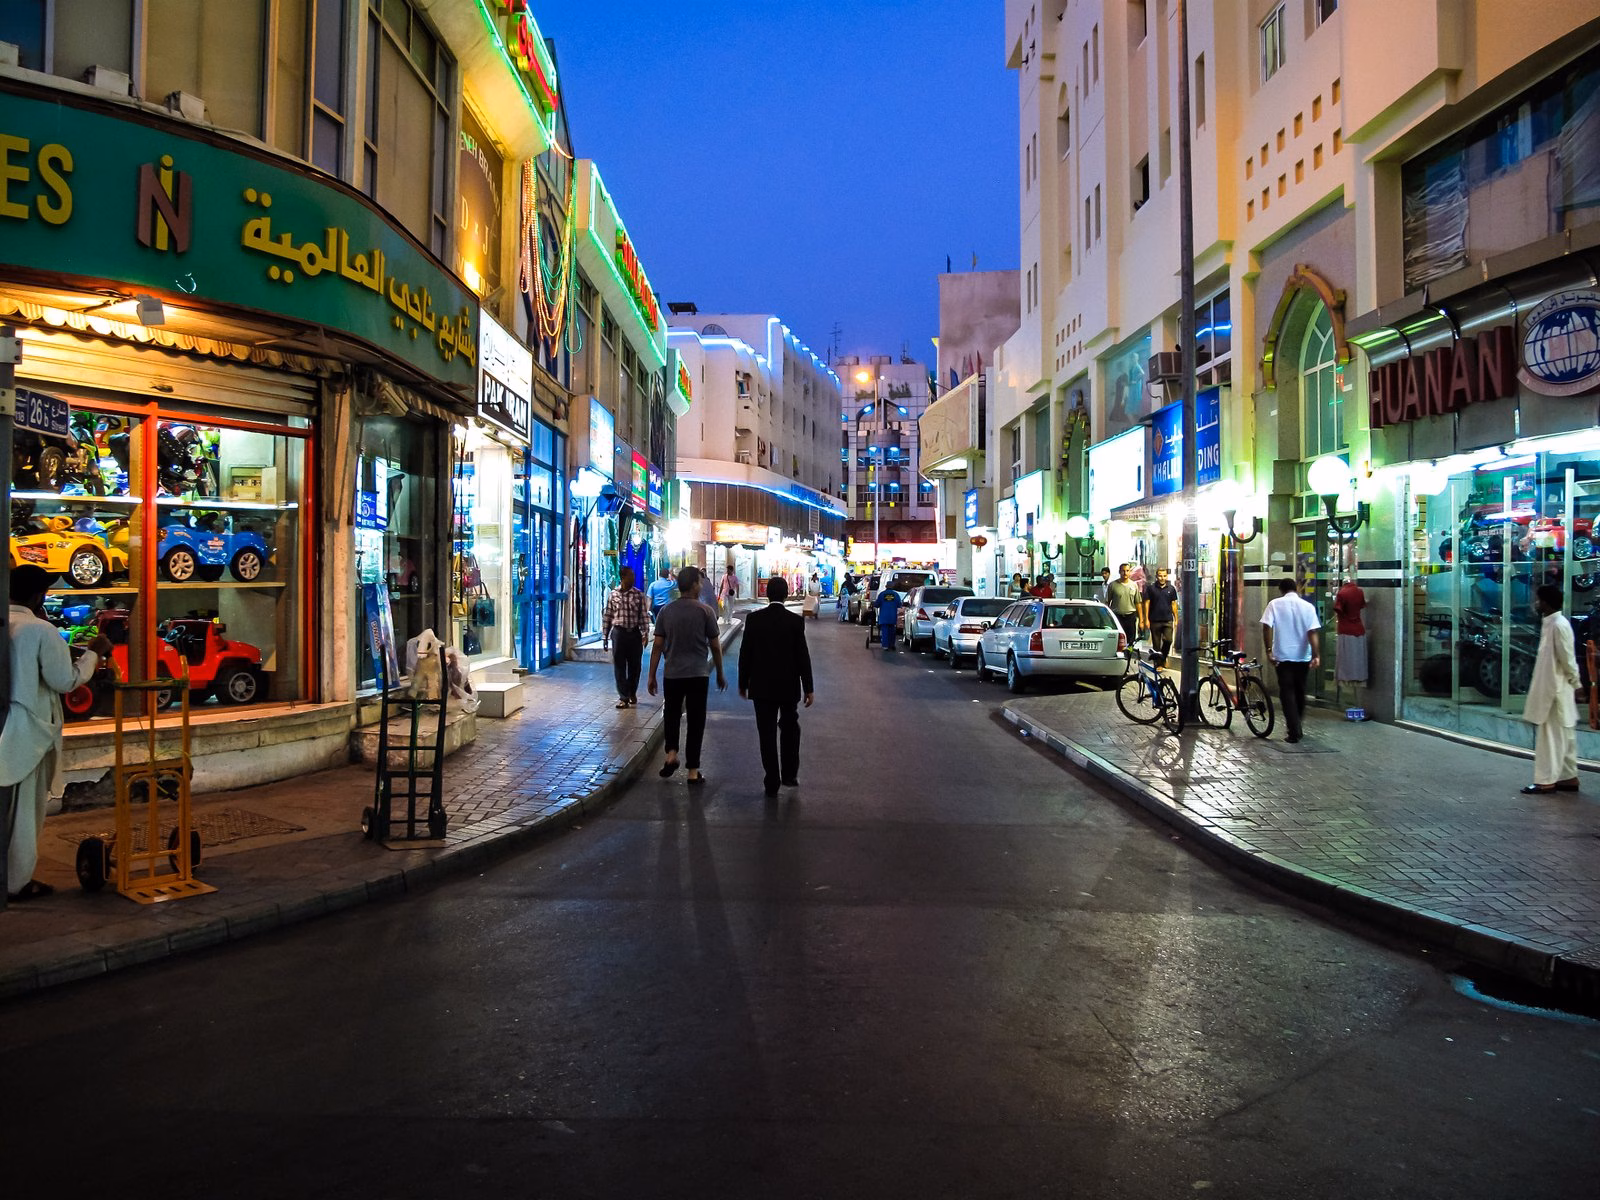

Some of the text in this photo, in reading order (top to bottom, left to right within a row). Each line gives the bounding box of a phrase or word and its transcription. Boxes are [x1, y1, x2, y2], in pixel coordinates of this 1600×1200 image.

[240, 187, 385, 296] العالمية
[389, 276, 436, 339] ناجي
[439, 306, 477, 367] مشاريع
[483, 374, 528, 430] PAK IRAN
[1368, 327, 1508, 429] HUANAN
[30, 397, 43, 425] 26
[51, 420, 67, 433] Street
[1197, 444, 1220, 472] DING
